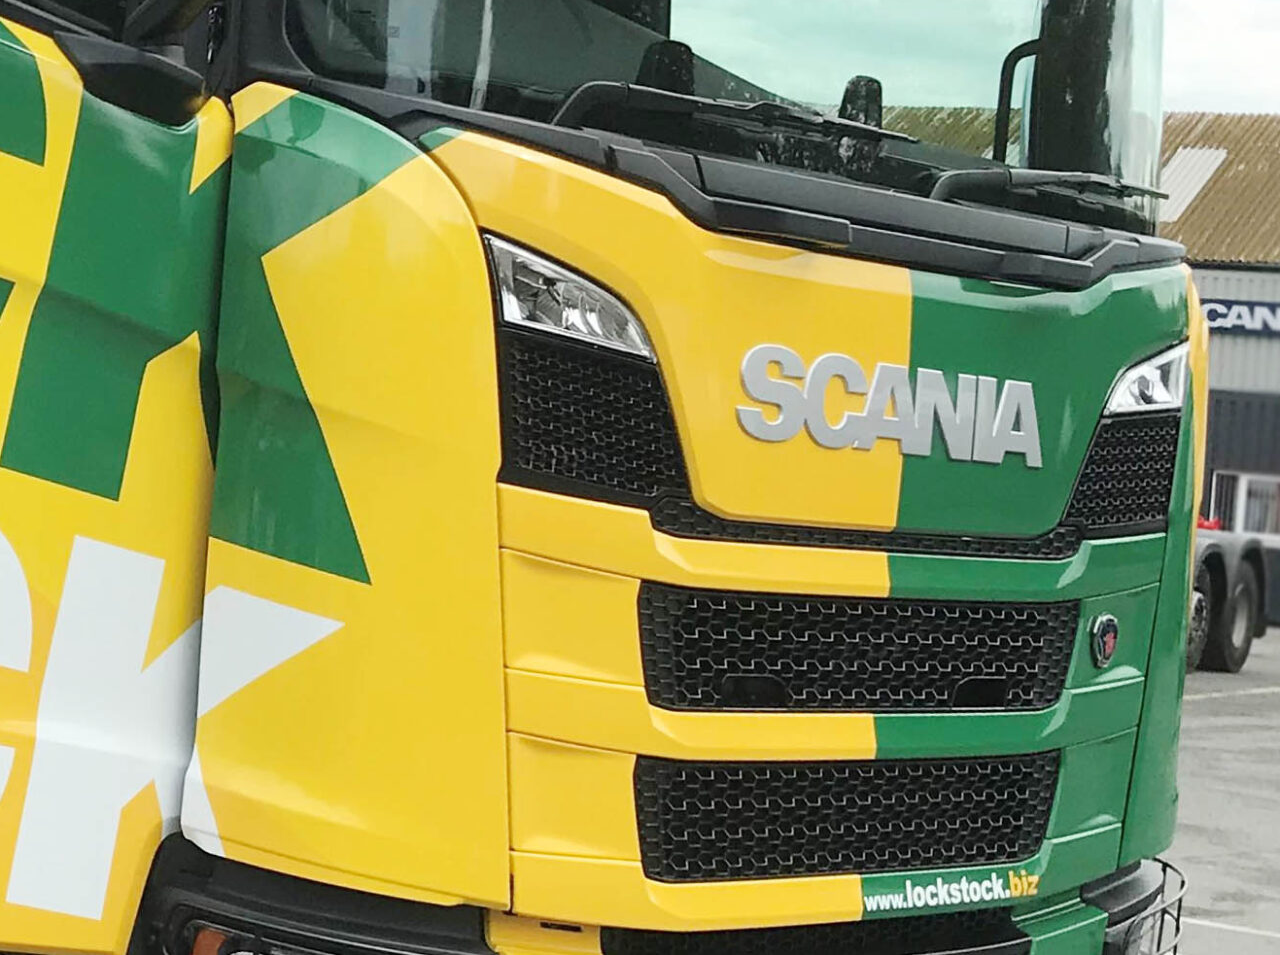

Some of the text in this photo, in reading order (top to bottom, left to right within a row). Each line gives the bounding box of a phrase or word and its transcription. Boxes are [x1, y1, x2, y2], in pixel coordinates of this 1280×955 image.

[1201, 302, 1280, 332] CAN
[735, 343, 1043, 469] SCANIA
[864, 870, 1040, 913] www.lockstock.biz
